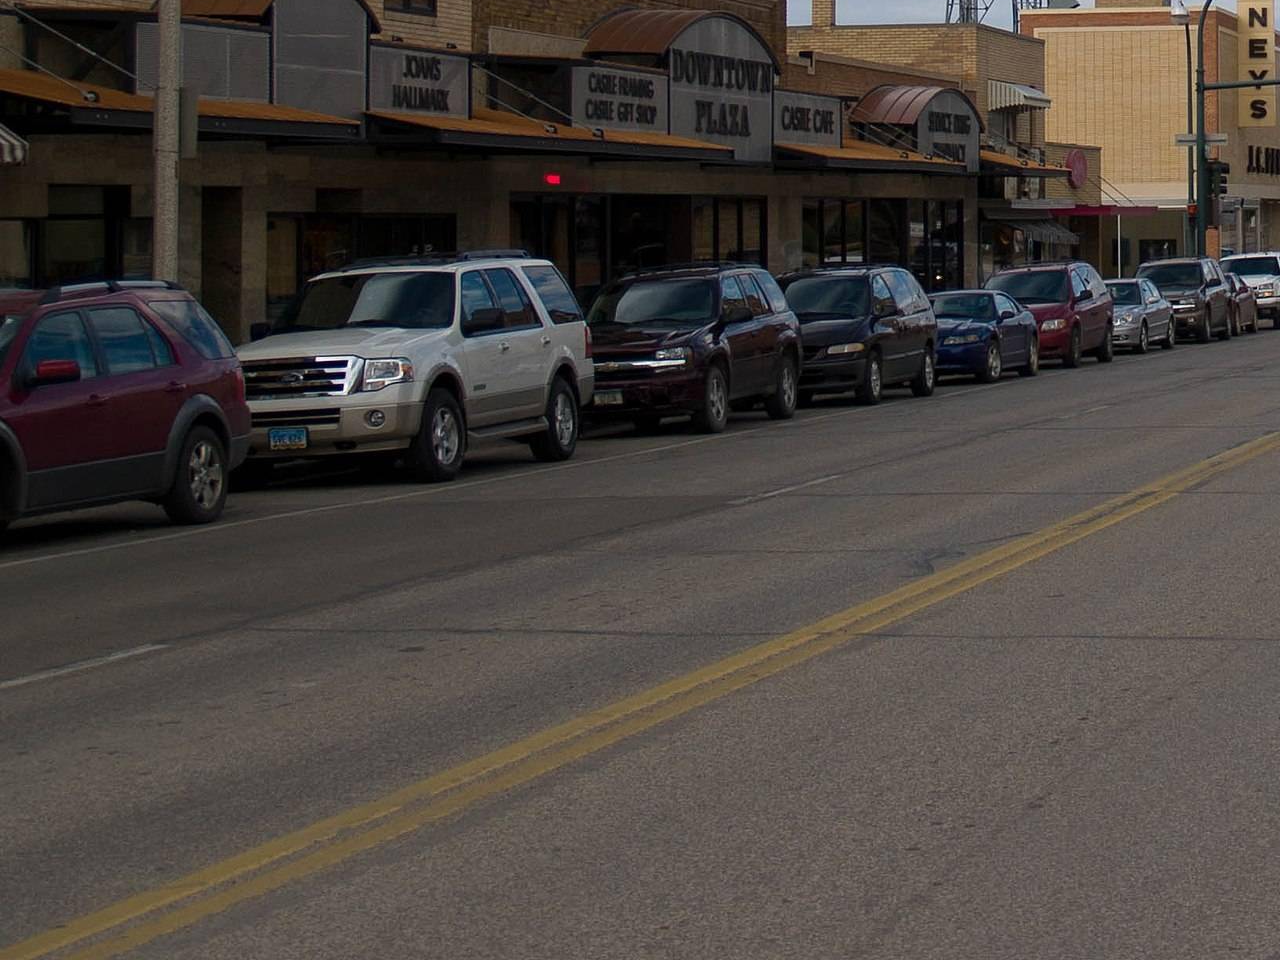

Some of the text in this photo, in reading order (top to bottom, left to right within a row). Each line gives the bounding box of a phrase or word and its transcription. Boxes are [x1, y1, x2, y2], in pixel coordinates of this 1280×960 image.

[588, 71, 655, 99] CASTLE FRAMING
[672, 48, 772, 93] DOWNTOWN
[391, 84, 451, 113] HALLMARK
[585, 98, 657, 125] CASTLE GIFT SHOP
[694, 100, 751, 138] PLAZA
[781, 105, 835, 135] CASTLE CAFE
